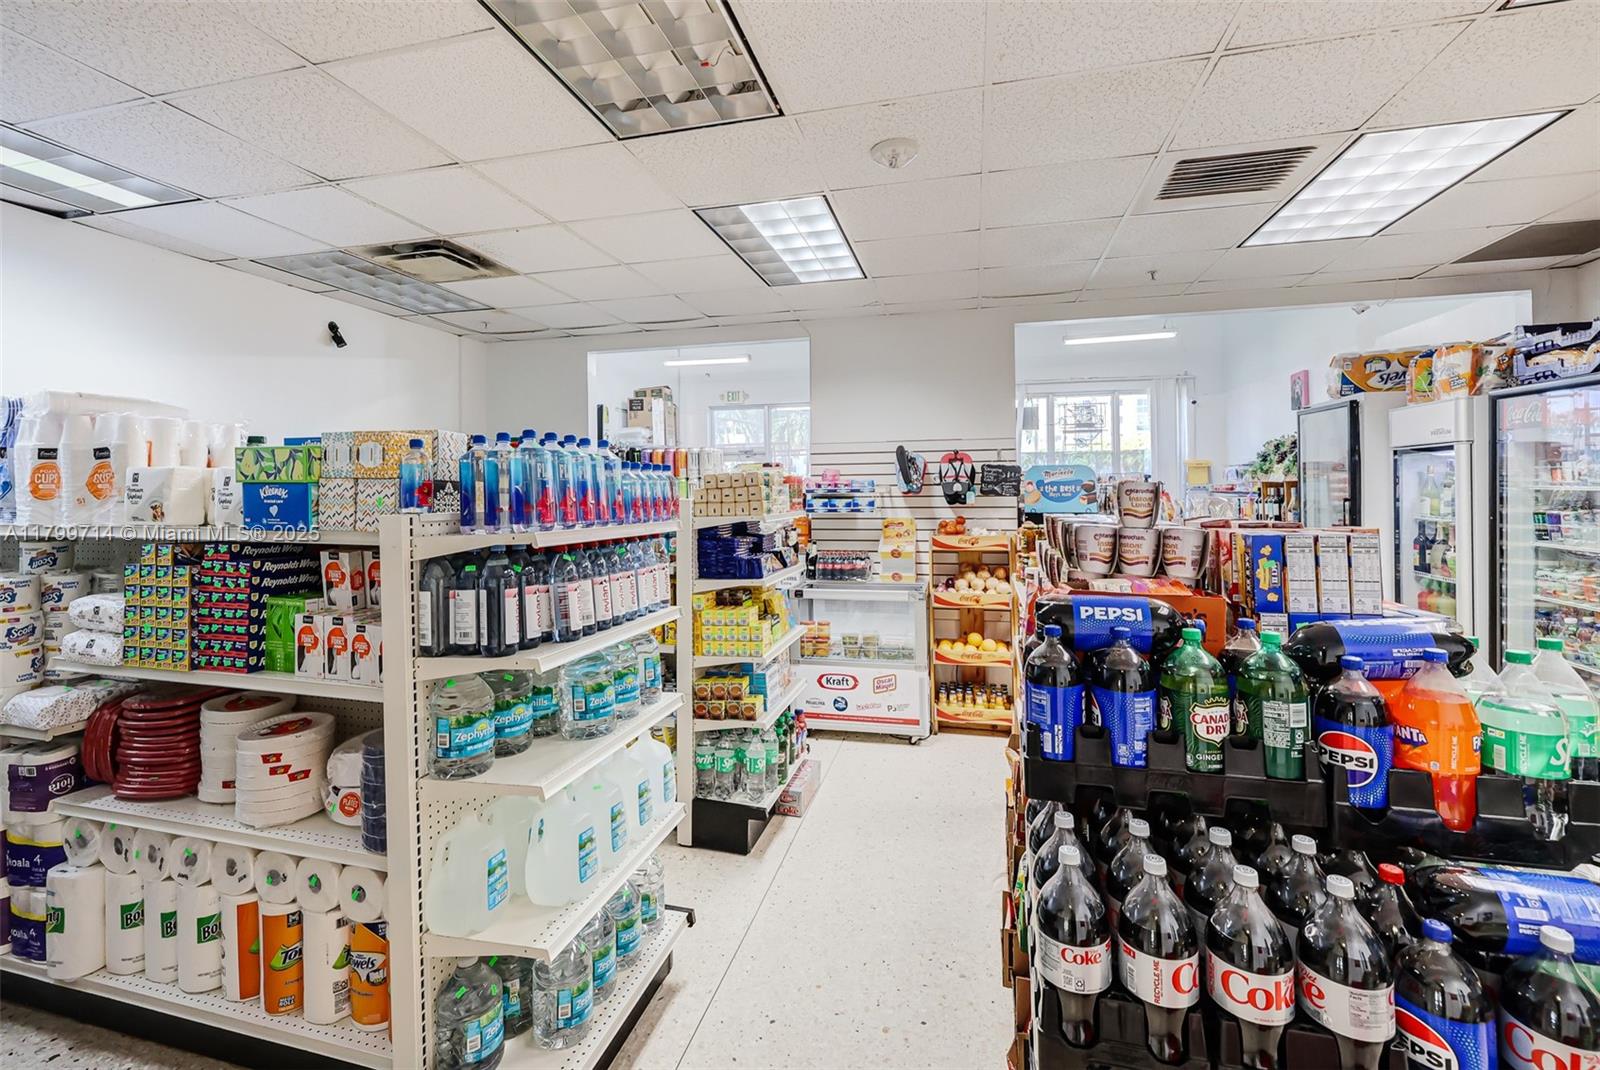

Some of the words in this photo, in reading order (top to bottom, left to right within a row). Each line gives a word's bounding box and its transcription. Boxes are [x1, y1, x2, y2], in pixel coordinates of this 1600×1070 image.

[727, 391, 740, 402] EXIT
[260, 484, 288, 499] Kleenex
[242, 546, 281, 556] Reynolds
[281, 544, 304, 554] Wrap
[262, 561, 299, 573] Reynolds
[299, 559, 320, 570] Wrap
[261, 576, 298, 589] Reynolds
[298, 574, 320, 586] Wrap
[1080, 606, 1143, 622] PEPSI
[11, 624, 36, 639] Scott
[825, 677, 850, 687] Kraft
[876, 677, 893, 685] Oscar
[1206, 725, 1228, 735] DRY
[1318, 747, 1375, 770] PEPSI
[1061, 947, 1102, 966] Coke
[1153, 960, 1160, 971] ME
